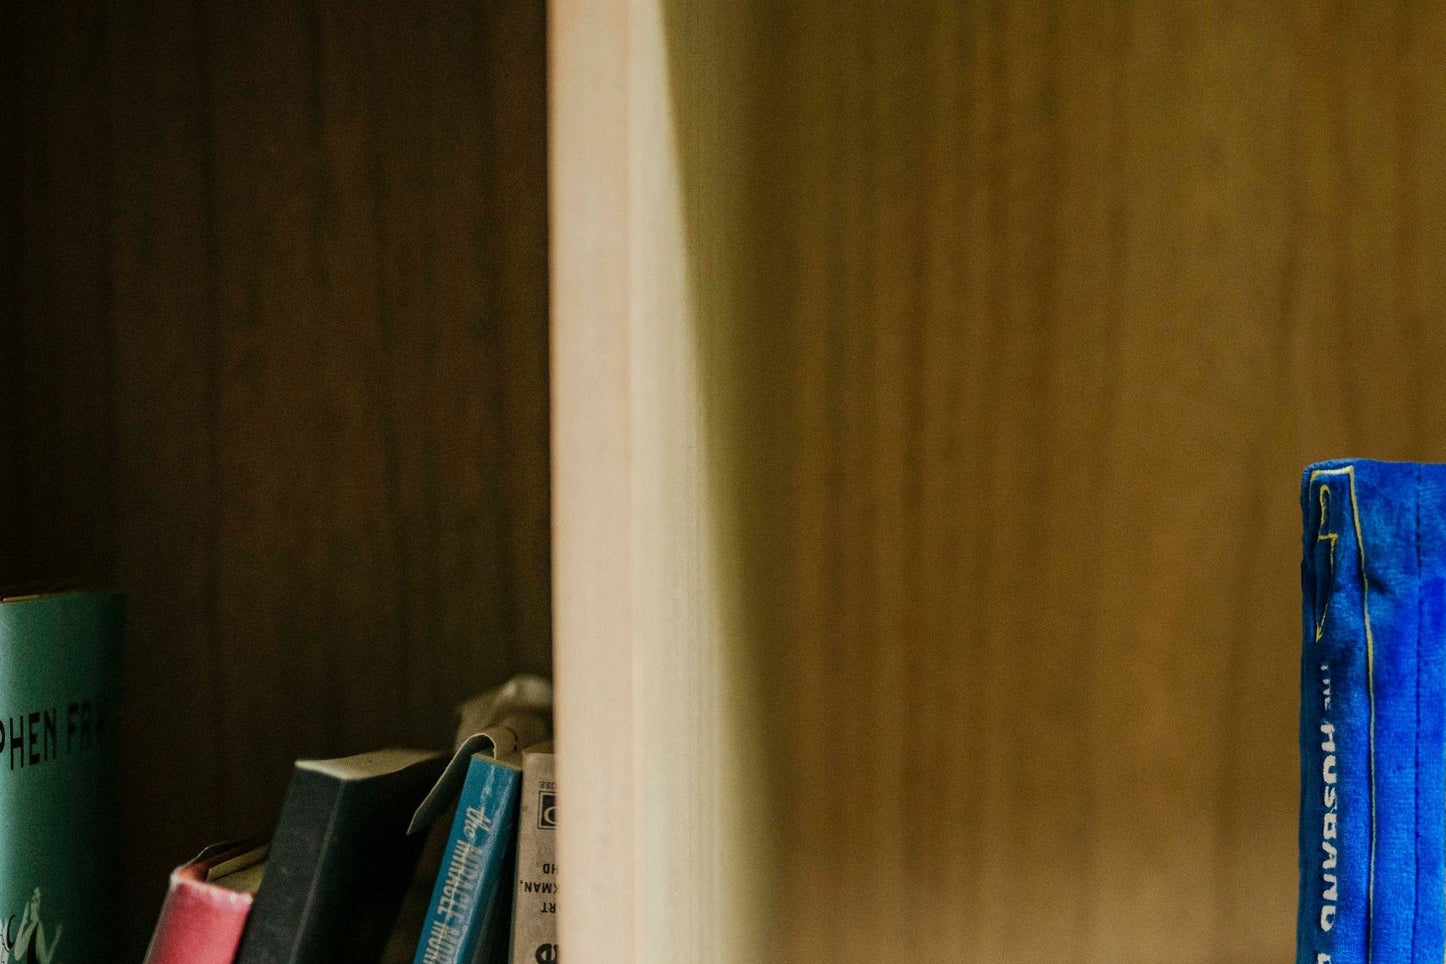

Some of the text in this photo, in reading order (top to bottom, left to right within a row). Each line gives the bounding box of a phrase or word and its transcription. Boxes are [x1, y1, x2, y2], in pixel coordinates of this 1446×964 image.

[463, 805, 492, 841] the
[1320, 721, 1338, 932] HUSBAND
[541, 902, 557, 914] RT
